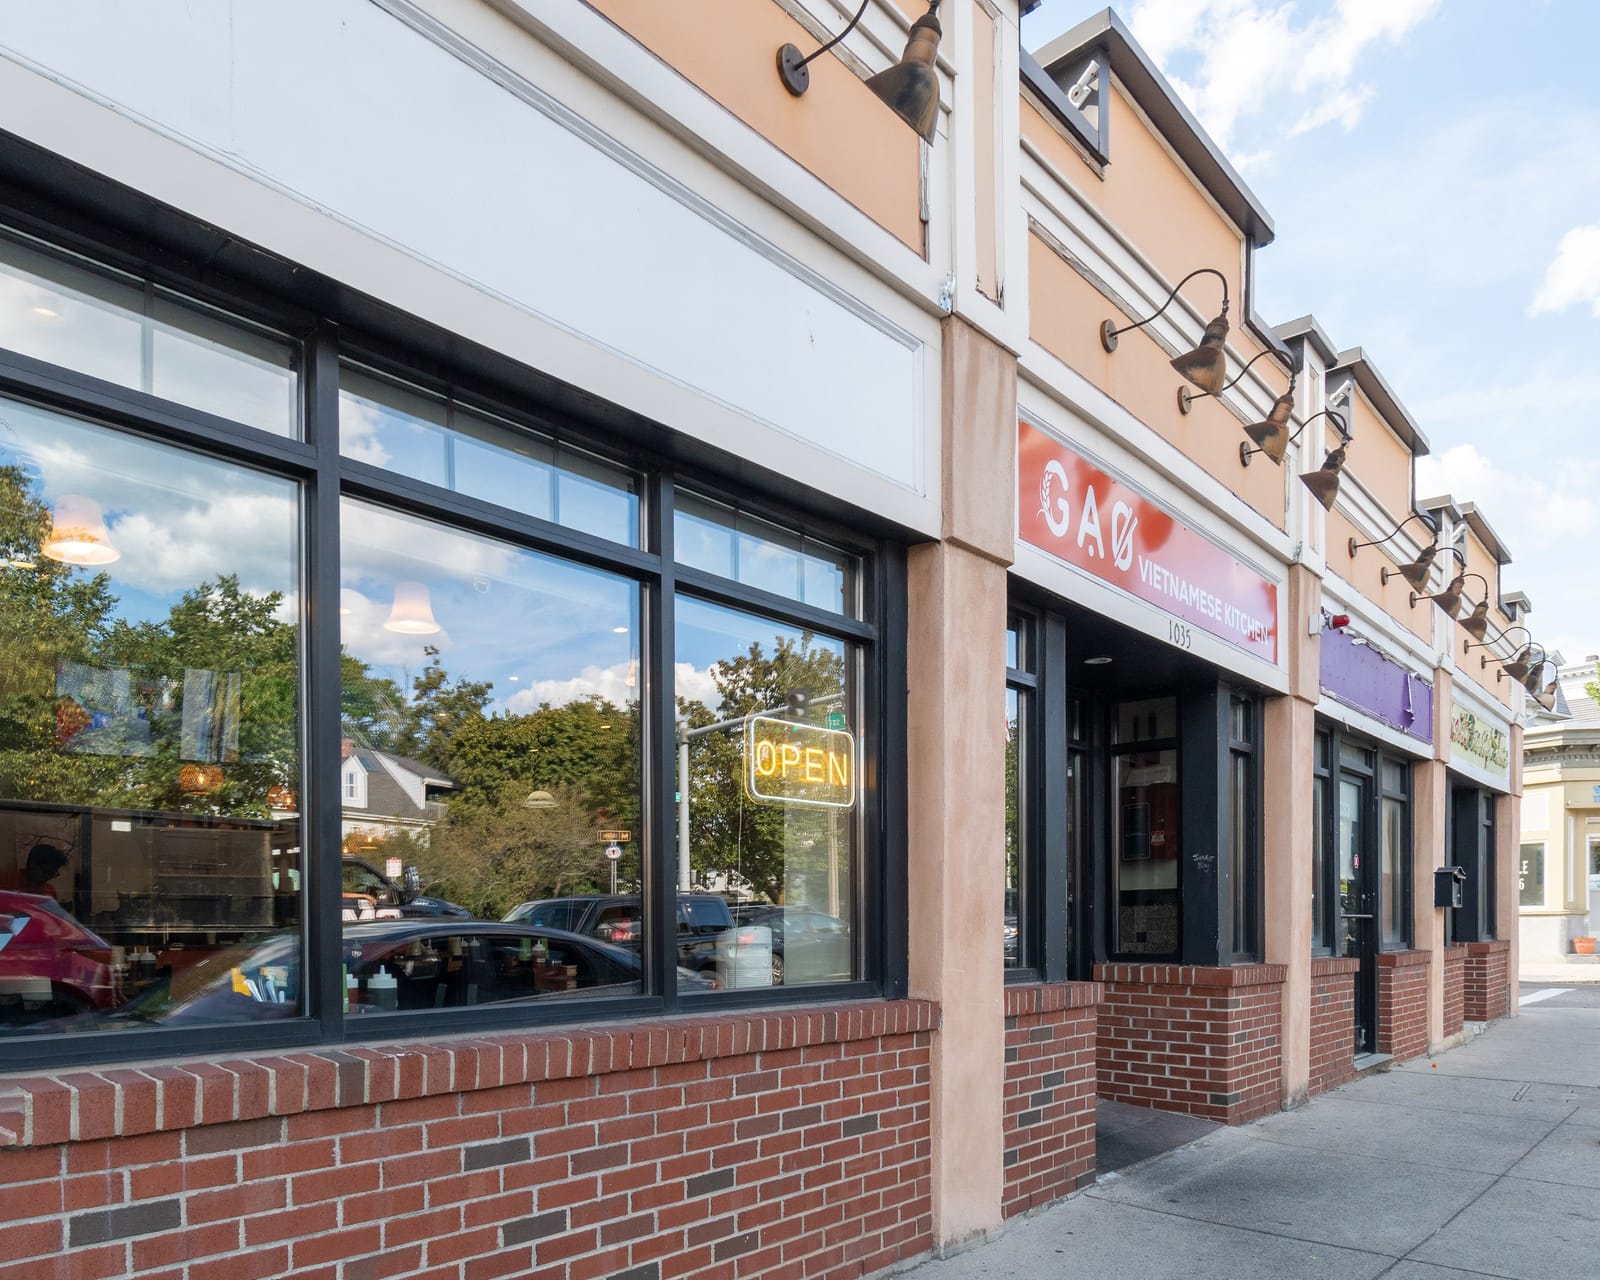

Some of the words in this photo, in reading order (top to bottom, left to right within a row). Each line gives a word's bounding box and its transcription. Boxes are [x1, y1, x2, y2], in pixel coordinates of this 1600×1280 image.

[1138, 555, 1222, 621] VIETNAMESE
[1224, 602, 1269, 645] KITCHEN
[1168, 619, 1192, 649] 1035
[756, 740, 848, 786] OPEN
